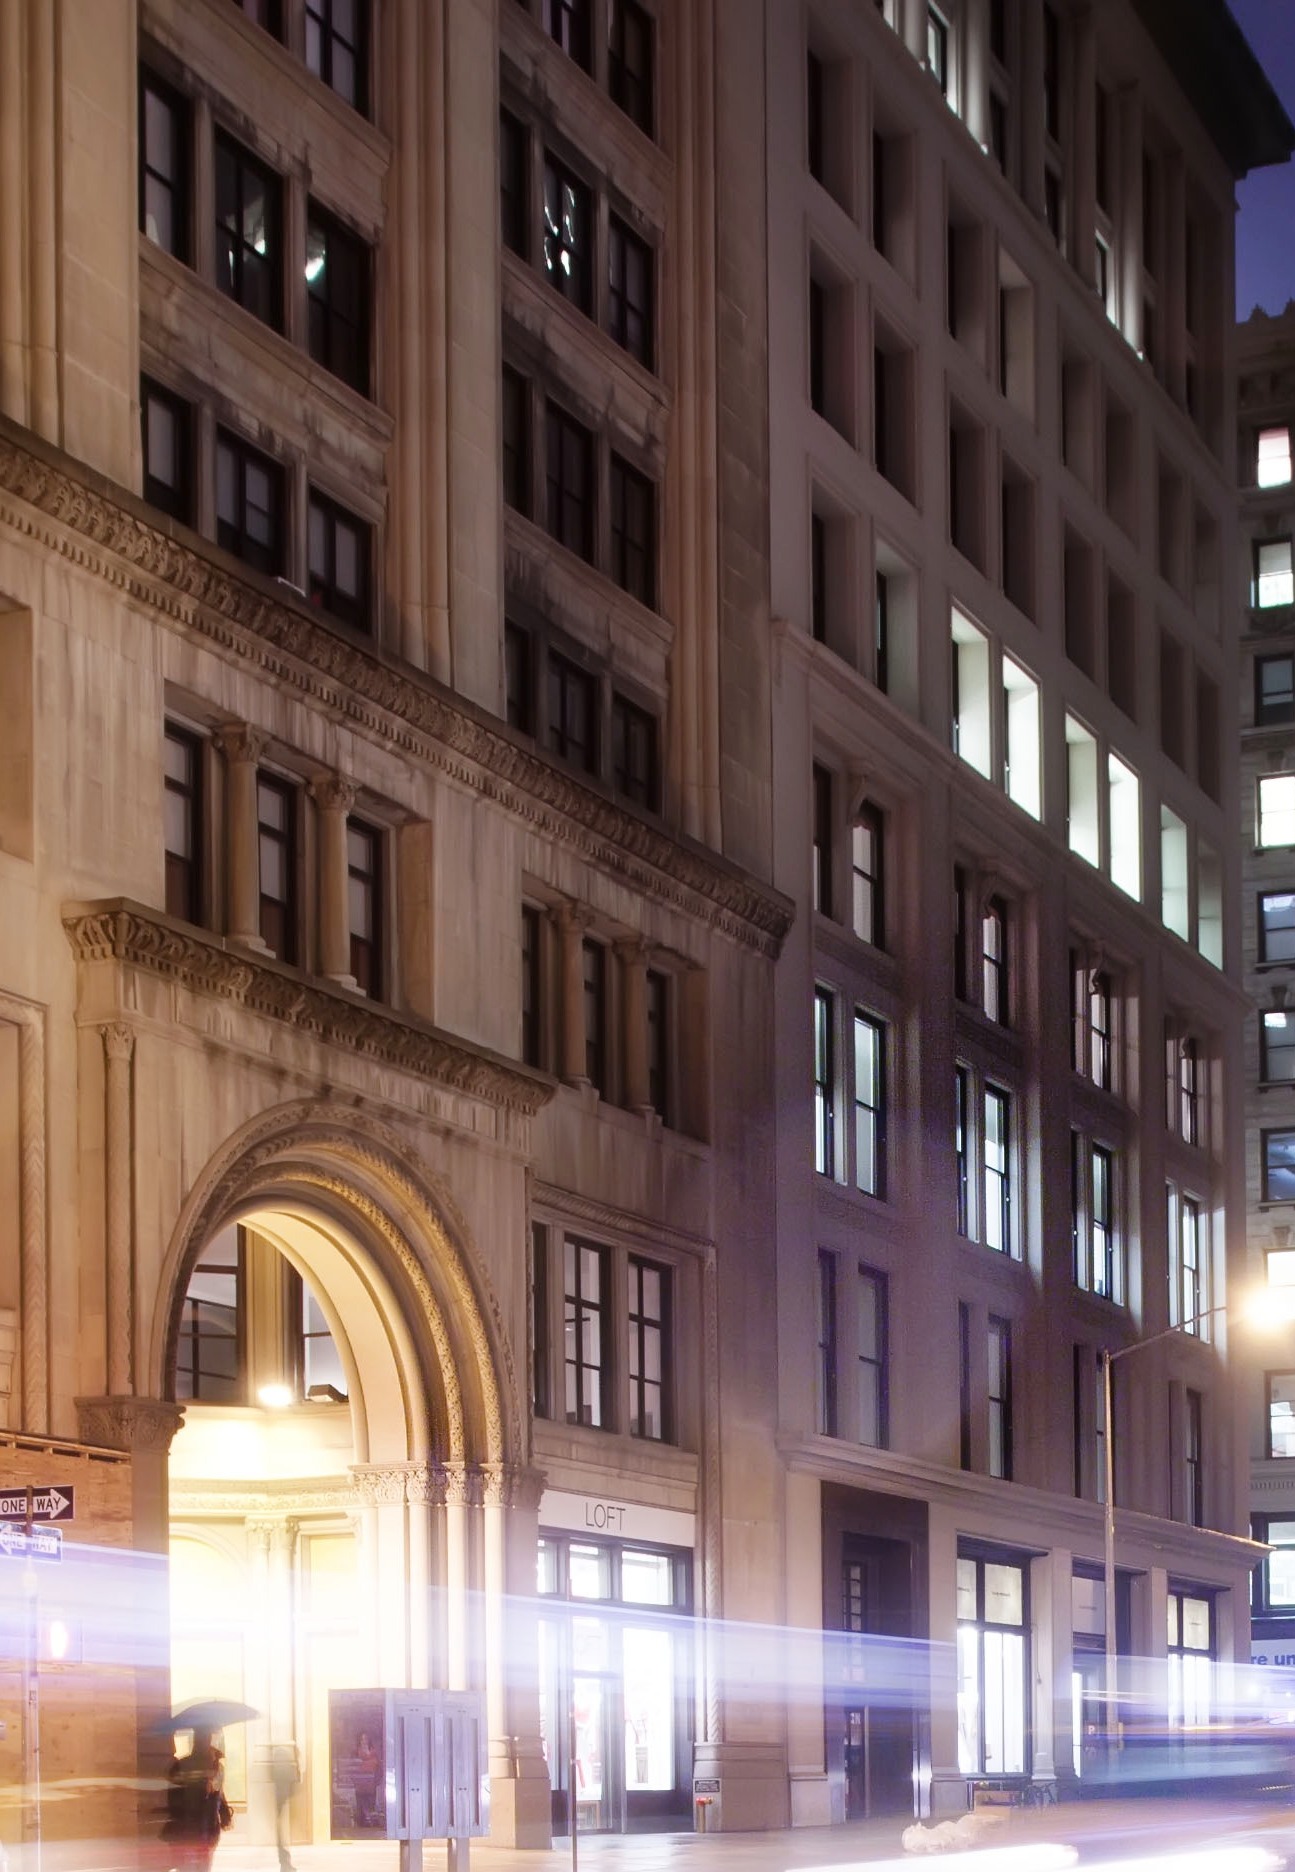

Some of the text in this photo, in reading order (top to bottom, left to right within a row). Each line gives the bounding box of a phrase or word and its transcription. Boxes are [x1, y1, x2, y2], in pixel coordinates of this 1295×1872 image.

[1, 1496, 62, 1513] ONE WAY
[585, 1502, 626, 1531] LOFT
